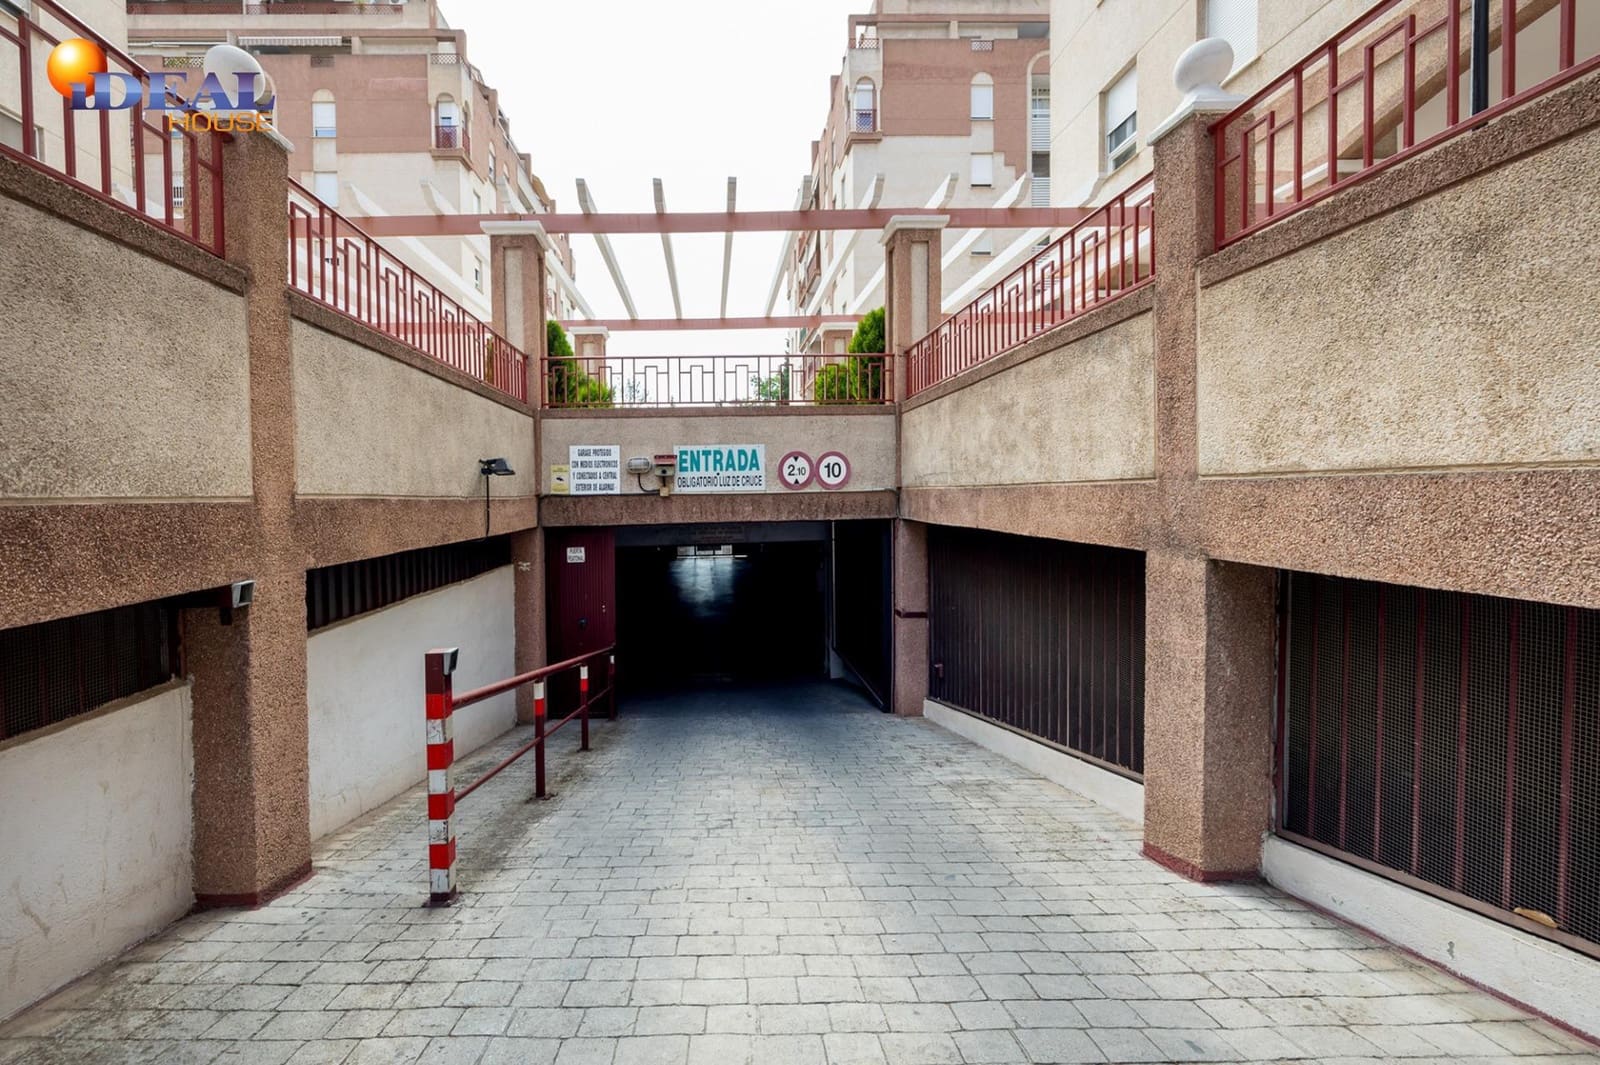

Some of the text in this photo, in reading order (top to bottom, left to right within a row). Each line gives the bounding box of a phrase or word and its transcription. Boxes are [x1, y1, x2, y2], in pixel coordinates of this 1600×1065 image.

[571, 460, 579, 468] CON
[580, 460, 593, 468] MEDIOS
[678, 448, 760, 473] ENTRADA
[824, 462, 842, 478] 10
[593, 483, 598, 491] DE
[677, 475, 763, 488] OBLIGATORIO LUZ DE CRUCE
